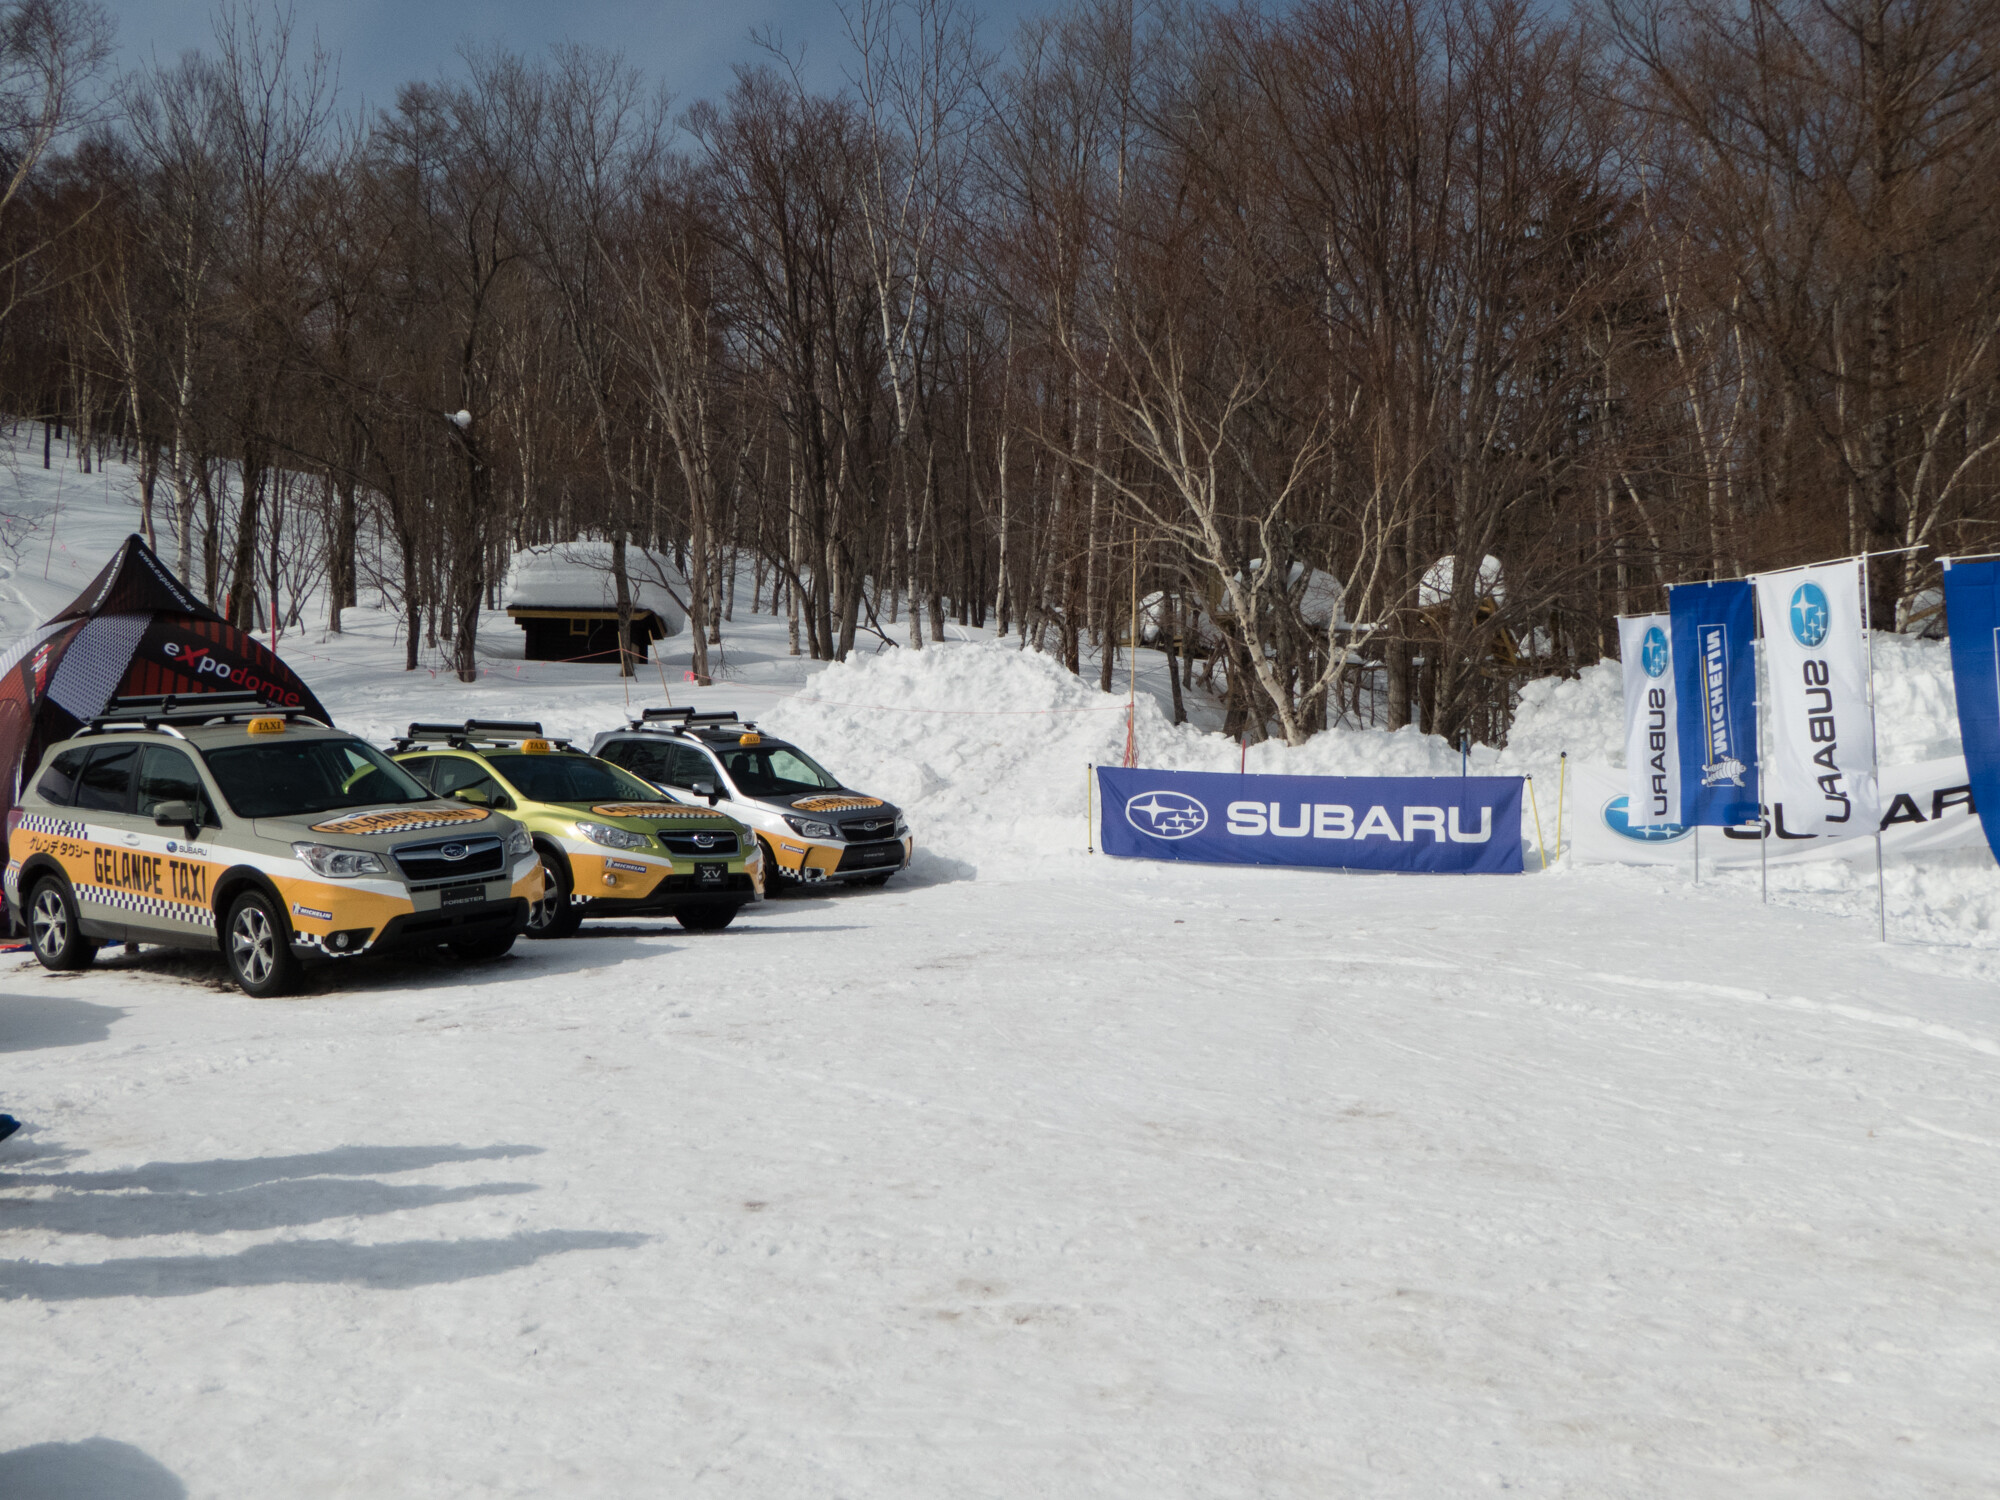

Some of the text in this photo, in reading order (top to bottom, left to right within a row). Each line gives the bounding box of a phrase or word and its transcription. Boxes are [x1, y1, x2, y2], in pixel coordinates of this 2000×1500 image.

[138, 549, 195, 612] www.expotrade.at
[258, 721, 281, 731] TAXI
[746, 735, 759, 743] TAXI
[530, 741, 548, 750] TAXI
[1226, 801, 1492, 843] SUBARU
[178, 845, 207, 856] SUBARU
[613, 863, 646, 872] MICHELIN
[95, 847, 206, 903] GELANDE TAXI
[703, 870, 721, 878] XV
[443, 896, 484, 906] FORESTER
[300, 908, 332, 919] MICHELIN
